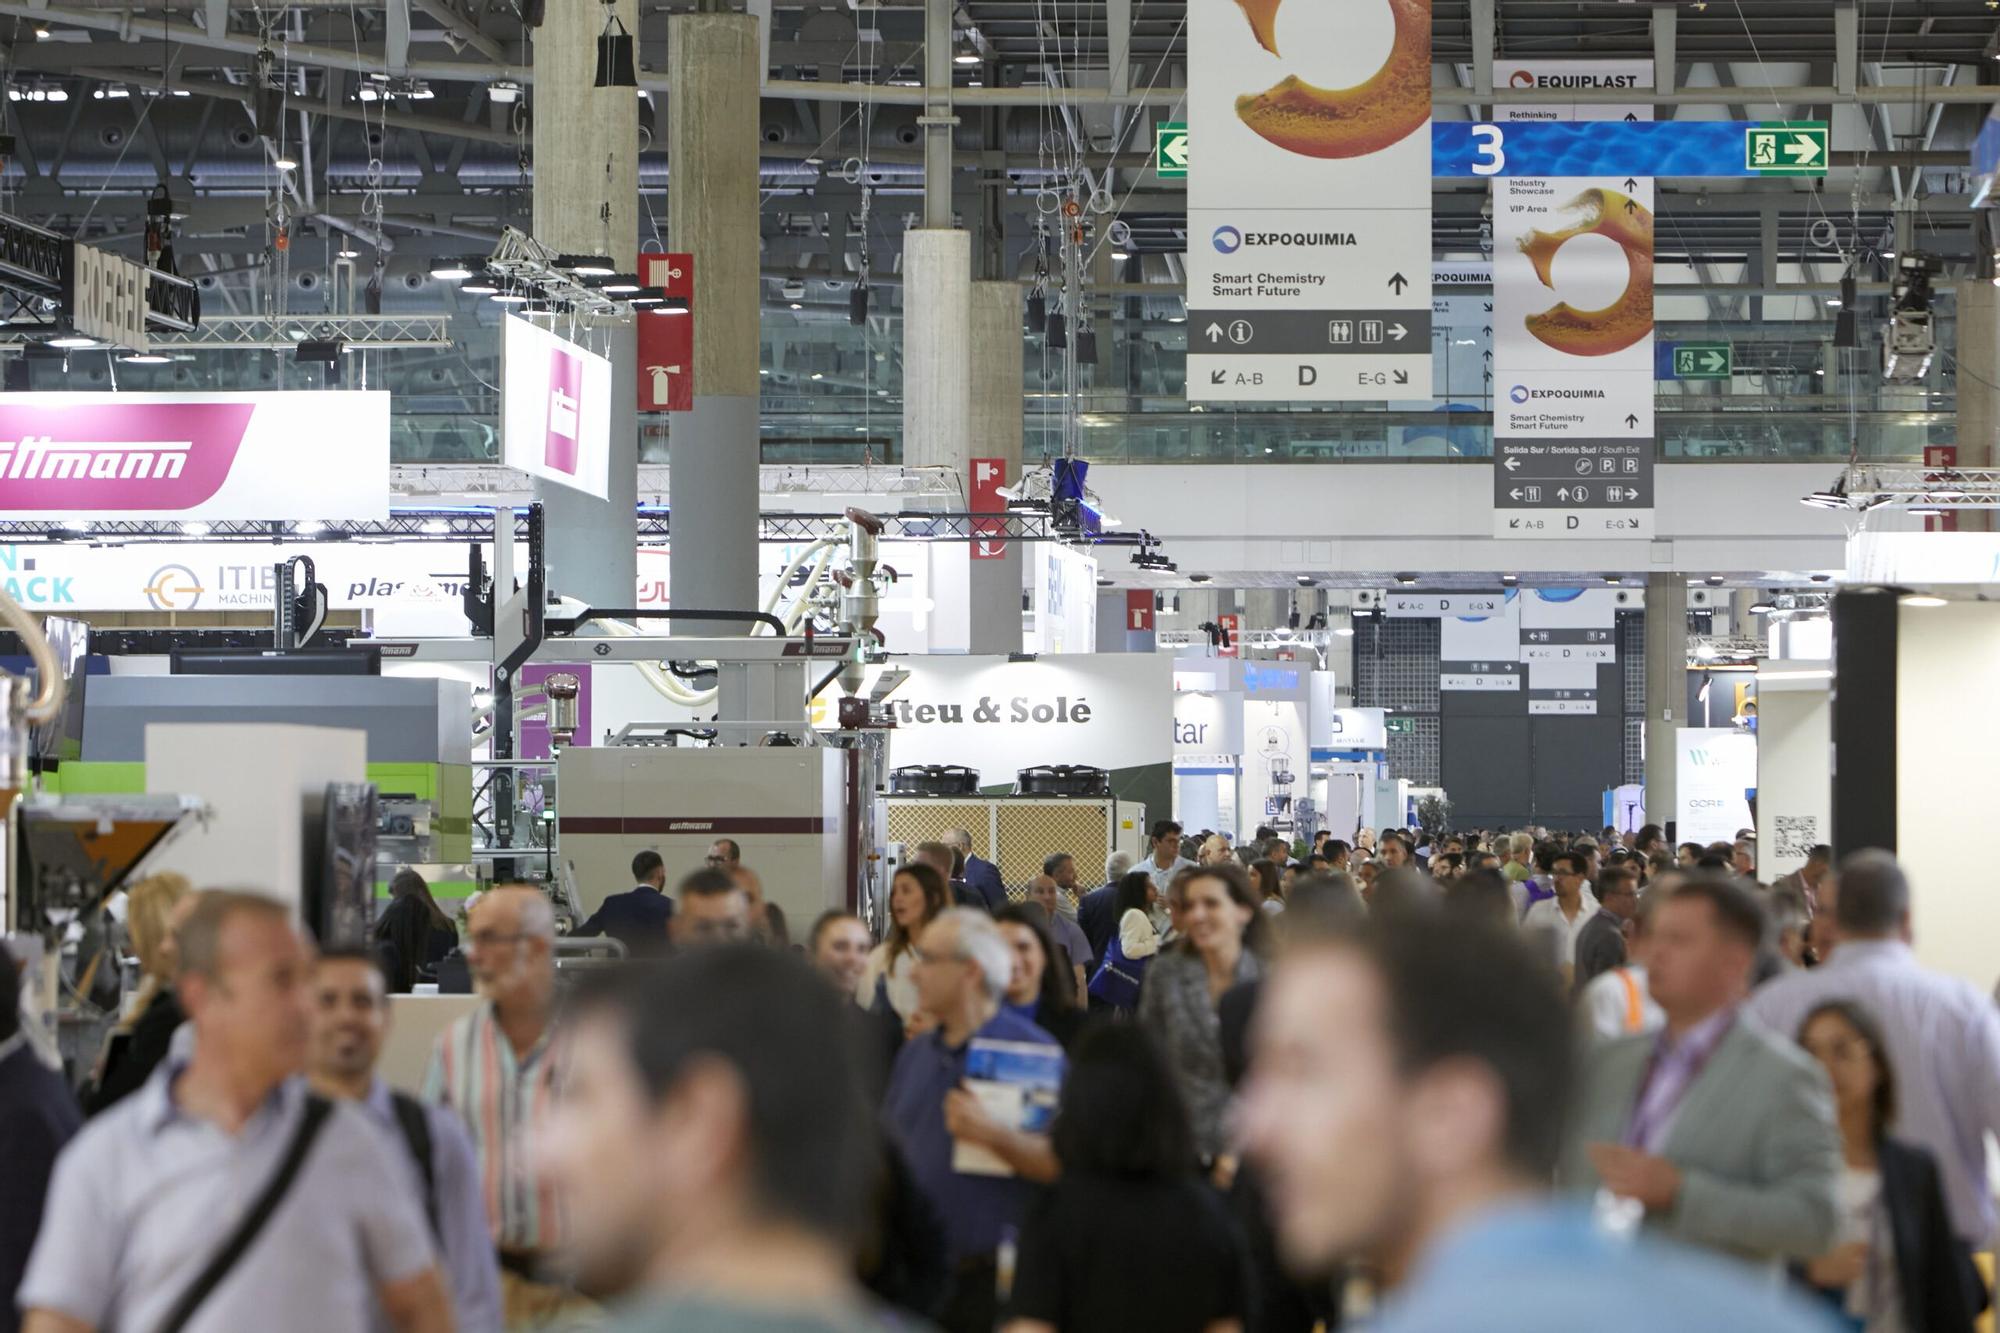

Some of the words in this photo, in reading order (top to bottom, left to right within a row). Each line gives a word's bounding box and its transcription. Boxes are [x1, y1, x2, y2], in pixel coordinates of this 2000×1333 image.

[1537, 75, 1637, 88] EQUIPLAST
[1510, 111, 1557, 120] Rethinking
[1471, 124, 1505, 175] 3
[1510, 179, 1546, 190] Industry
[1510, 187, 1554, 196] Showcase
[1510, 205, 1524, 213] VIP
[1527, 205, 1547, 213] Area
[1244, 233, 1357, 246] EXPOQUIMIA
[1212, 273, 1252, 284] Smart
[1257, 272, 1325, 285] Chemistry
[1432, 273, 1492, 282] POQUIMIA
[1212, 285, 1252, 296] Smart
[1257, 285, 1300, 296] Future
[1235, 373, 1264, 385] A-B
[1298, 365, 1317, 386] D
[1358, 373, 1386, 385] E-G
[1531, 390, 1605, 398] EXPOQUIMIA
[1539, 414, 1585, 423] Chemistry
[1504, 446, 1529, 454] Salida
[1530, 446, 1545, 454] Sur
[1551, 446, 1580, 454] Sortida
[1580, 446, 1597, 454] Sud
[1602, 446, 1625, 454] South
[1626, 446, 1640, 454] Exit
[1525, 520, 1545, 529] A-B
[1566, 516, 1579, 529] D
[1605, 520, 1625, 529] E-G
[1440, 600, 1450, 610] D
[1563, 649, 1571, 657] D
[972, 697, 1000, 723] &
[1011, 696, 1091, 723] Solé
